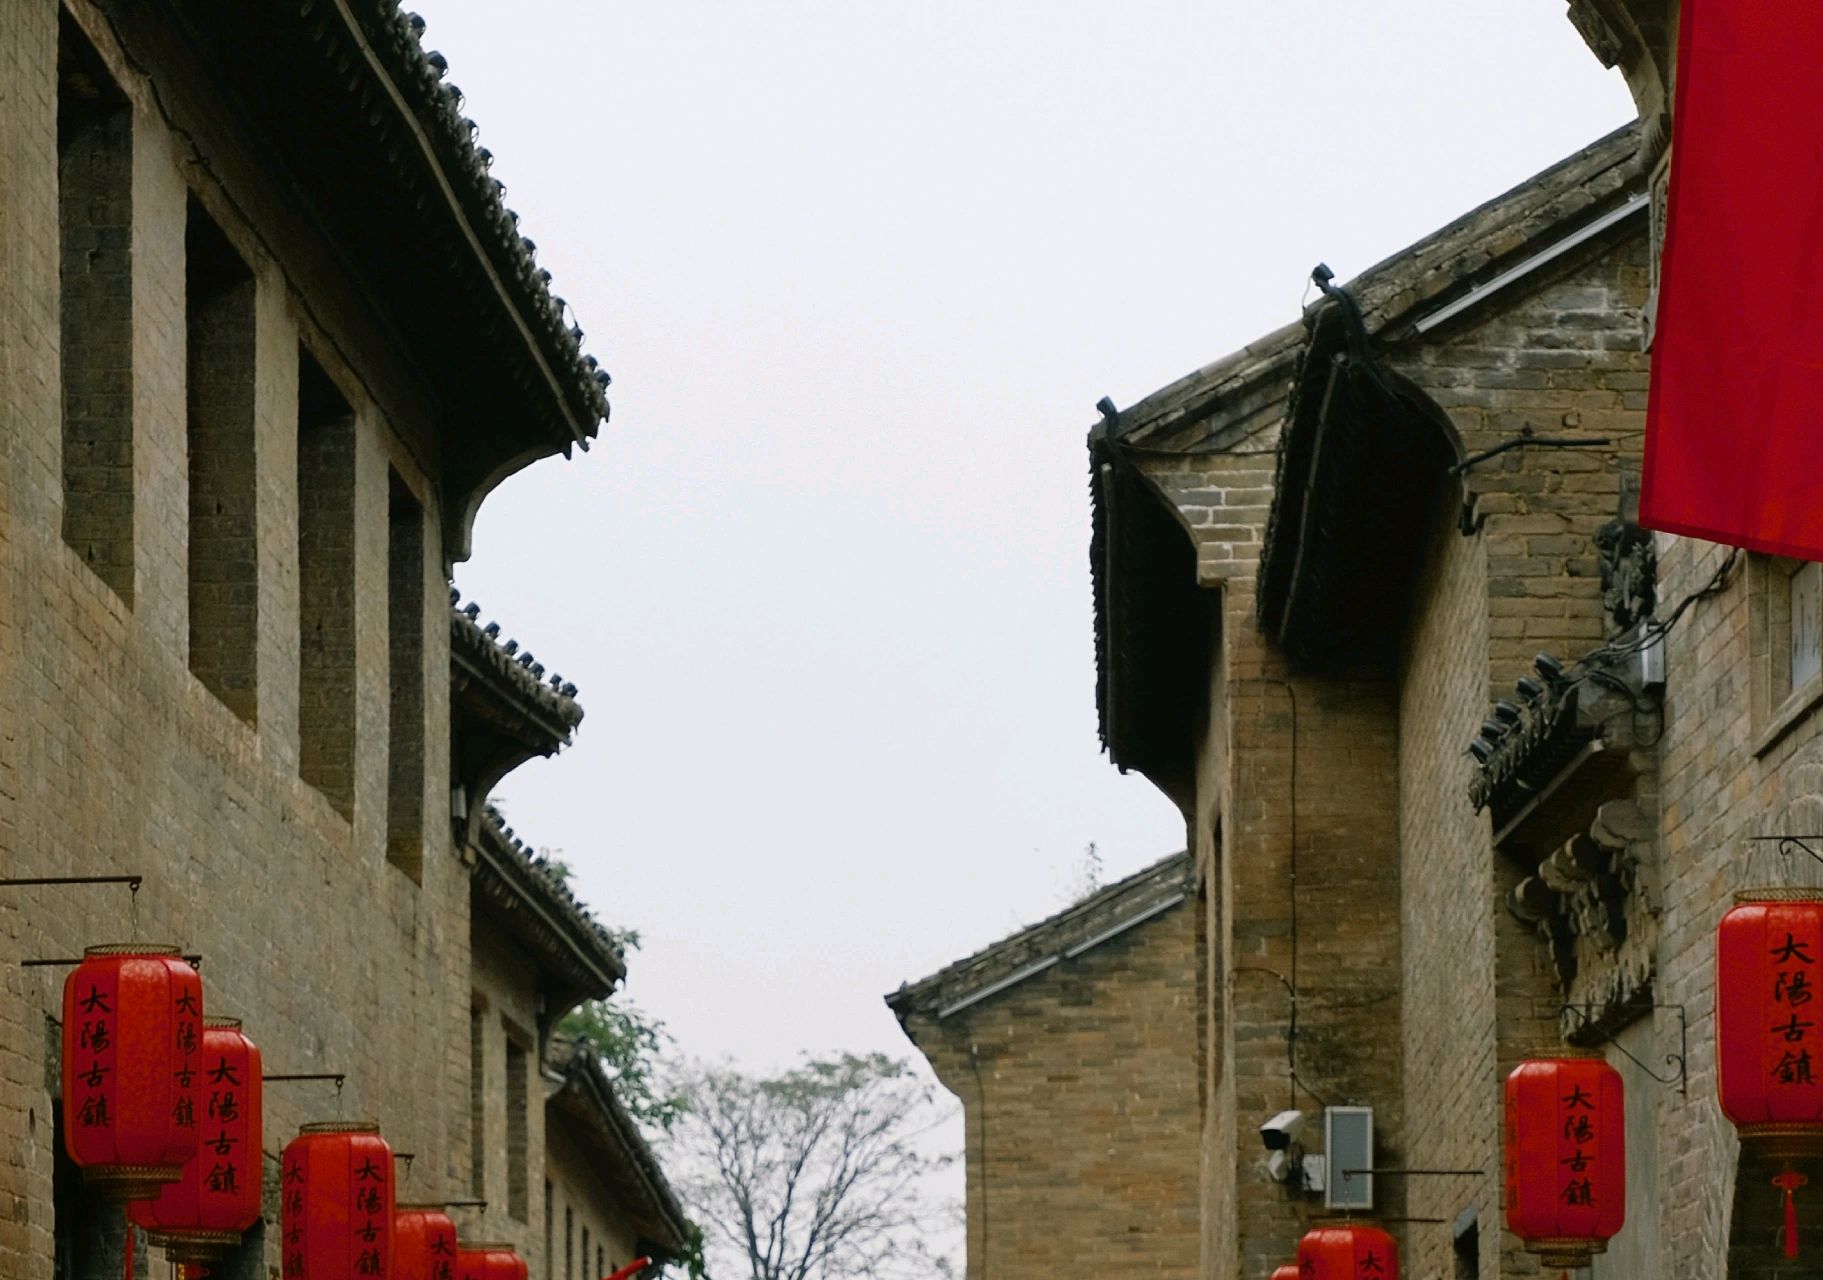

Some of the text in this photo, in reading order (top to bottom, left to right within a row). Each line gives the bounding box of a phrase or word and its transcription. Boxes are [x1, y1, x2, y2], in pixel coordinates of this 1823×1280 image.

[76, 984, 112, 1128] 大陽古鎮
[171, 986, 199, 1130] 大陽古鎮
[1770, 932, 1818, 1087] 大陽古鎮
[203, 1057, 241, 1196] 大陽古鎮
[1560, 1083, 1595, 1208] 大陽古鎮
[354, 1156, 384, 1277] 大陽古鎮
